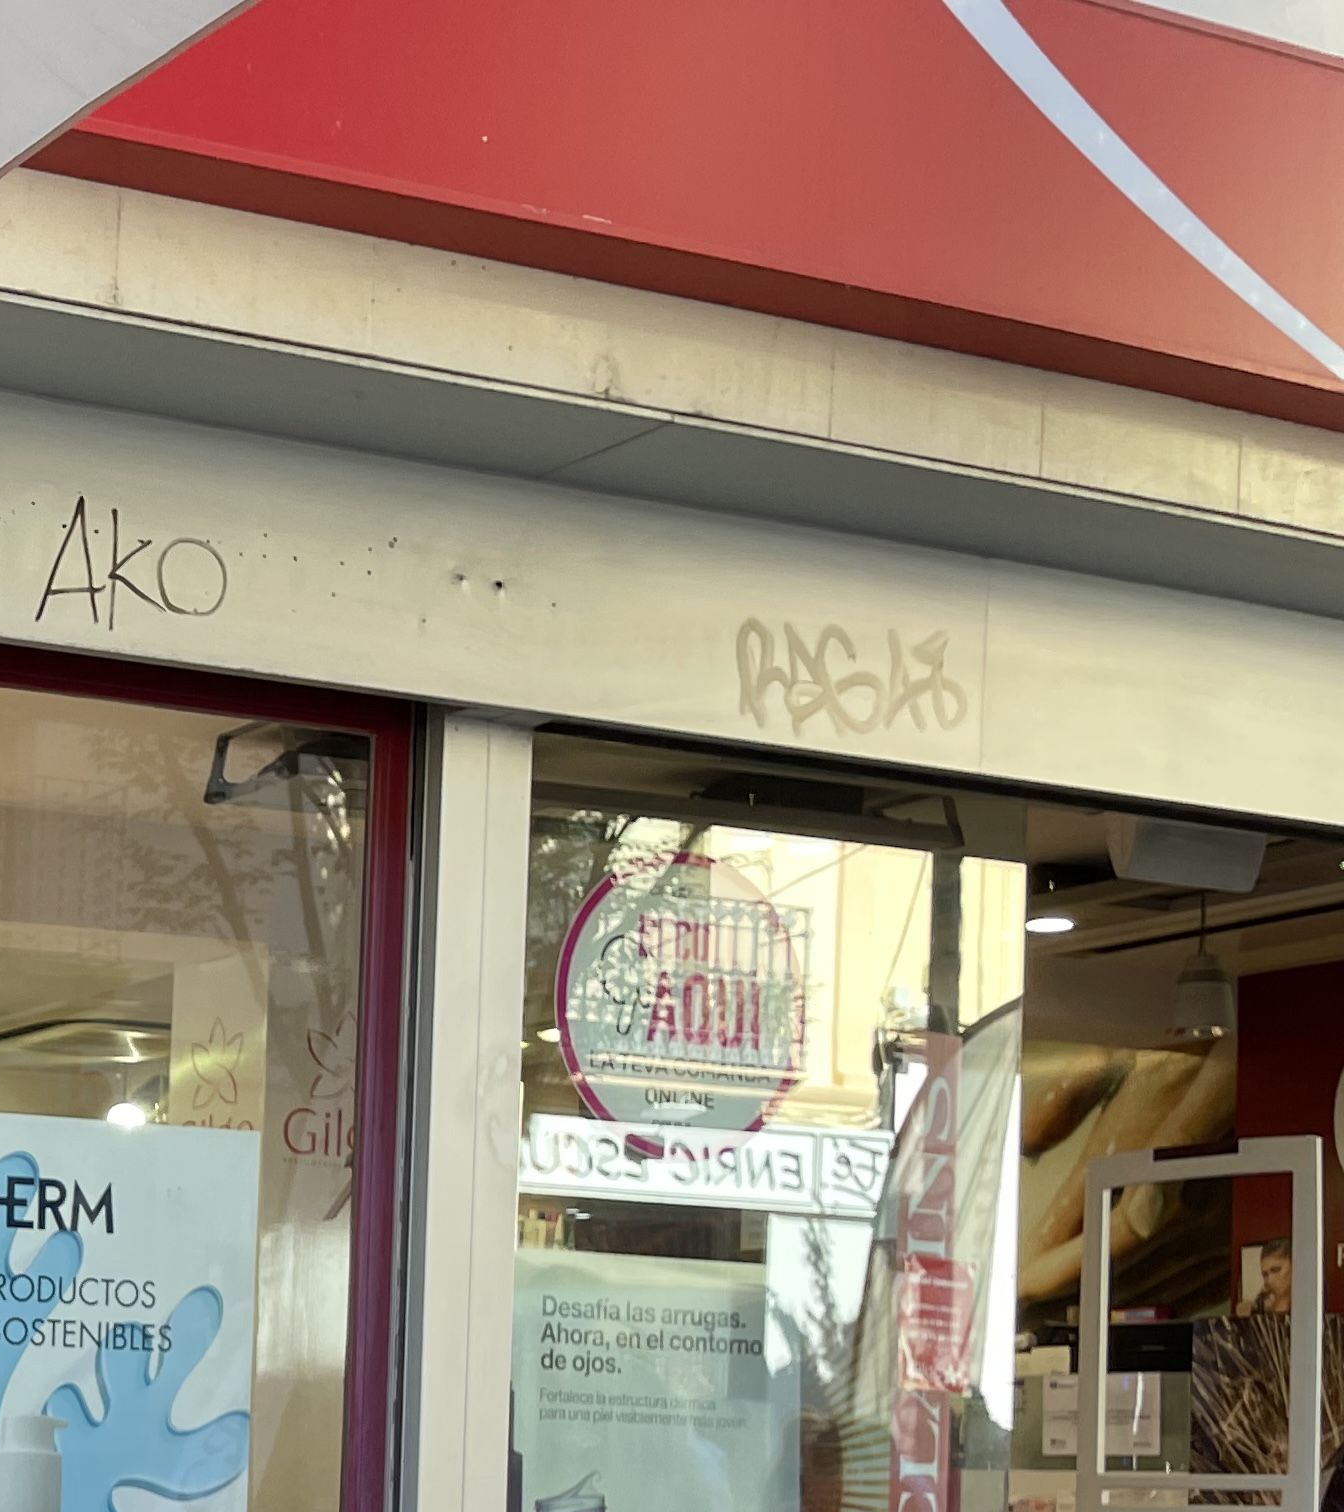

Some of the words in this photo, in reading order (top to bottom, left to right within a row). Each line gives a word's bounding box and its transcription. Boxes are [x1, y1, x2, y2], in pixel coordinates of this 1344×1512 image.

[542, 1295, 620, 1321] Desafía
[626, 1300, 656, 1323] las
[662, 1307, 746, 1331] arrugas.
[541, 1322, 610, 1350] Ahora,
[616, 1331, 641, 1349] en
[646, 1330, 665, 1350] el
[670, 1334, 763, 1356] contorno
[541, 1349, 567, 1370] de
[572, 1350, 622, 1377] ojos.
